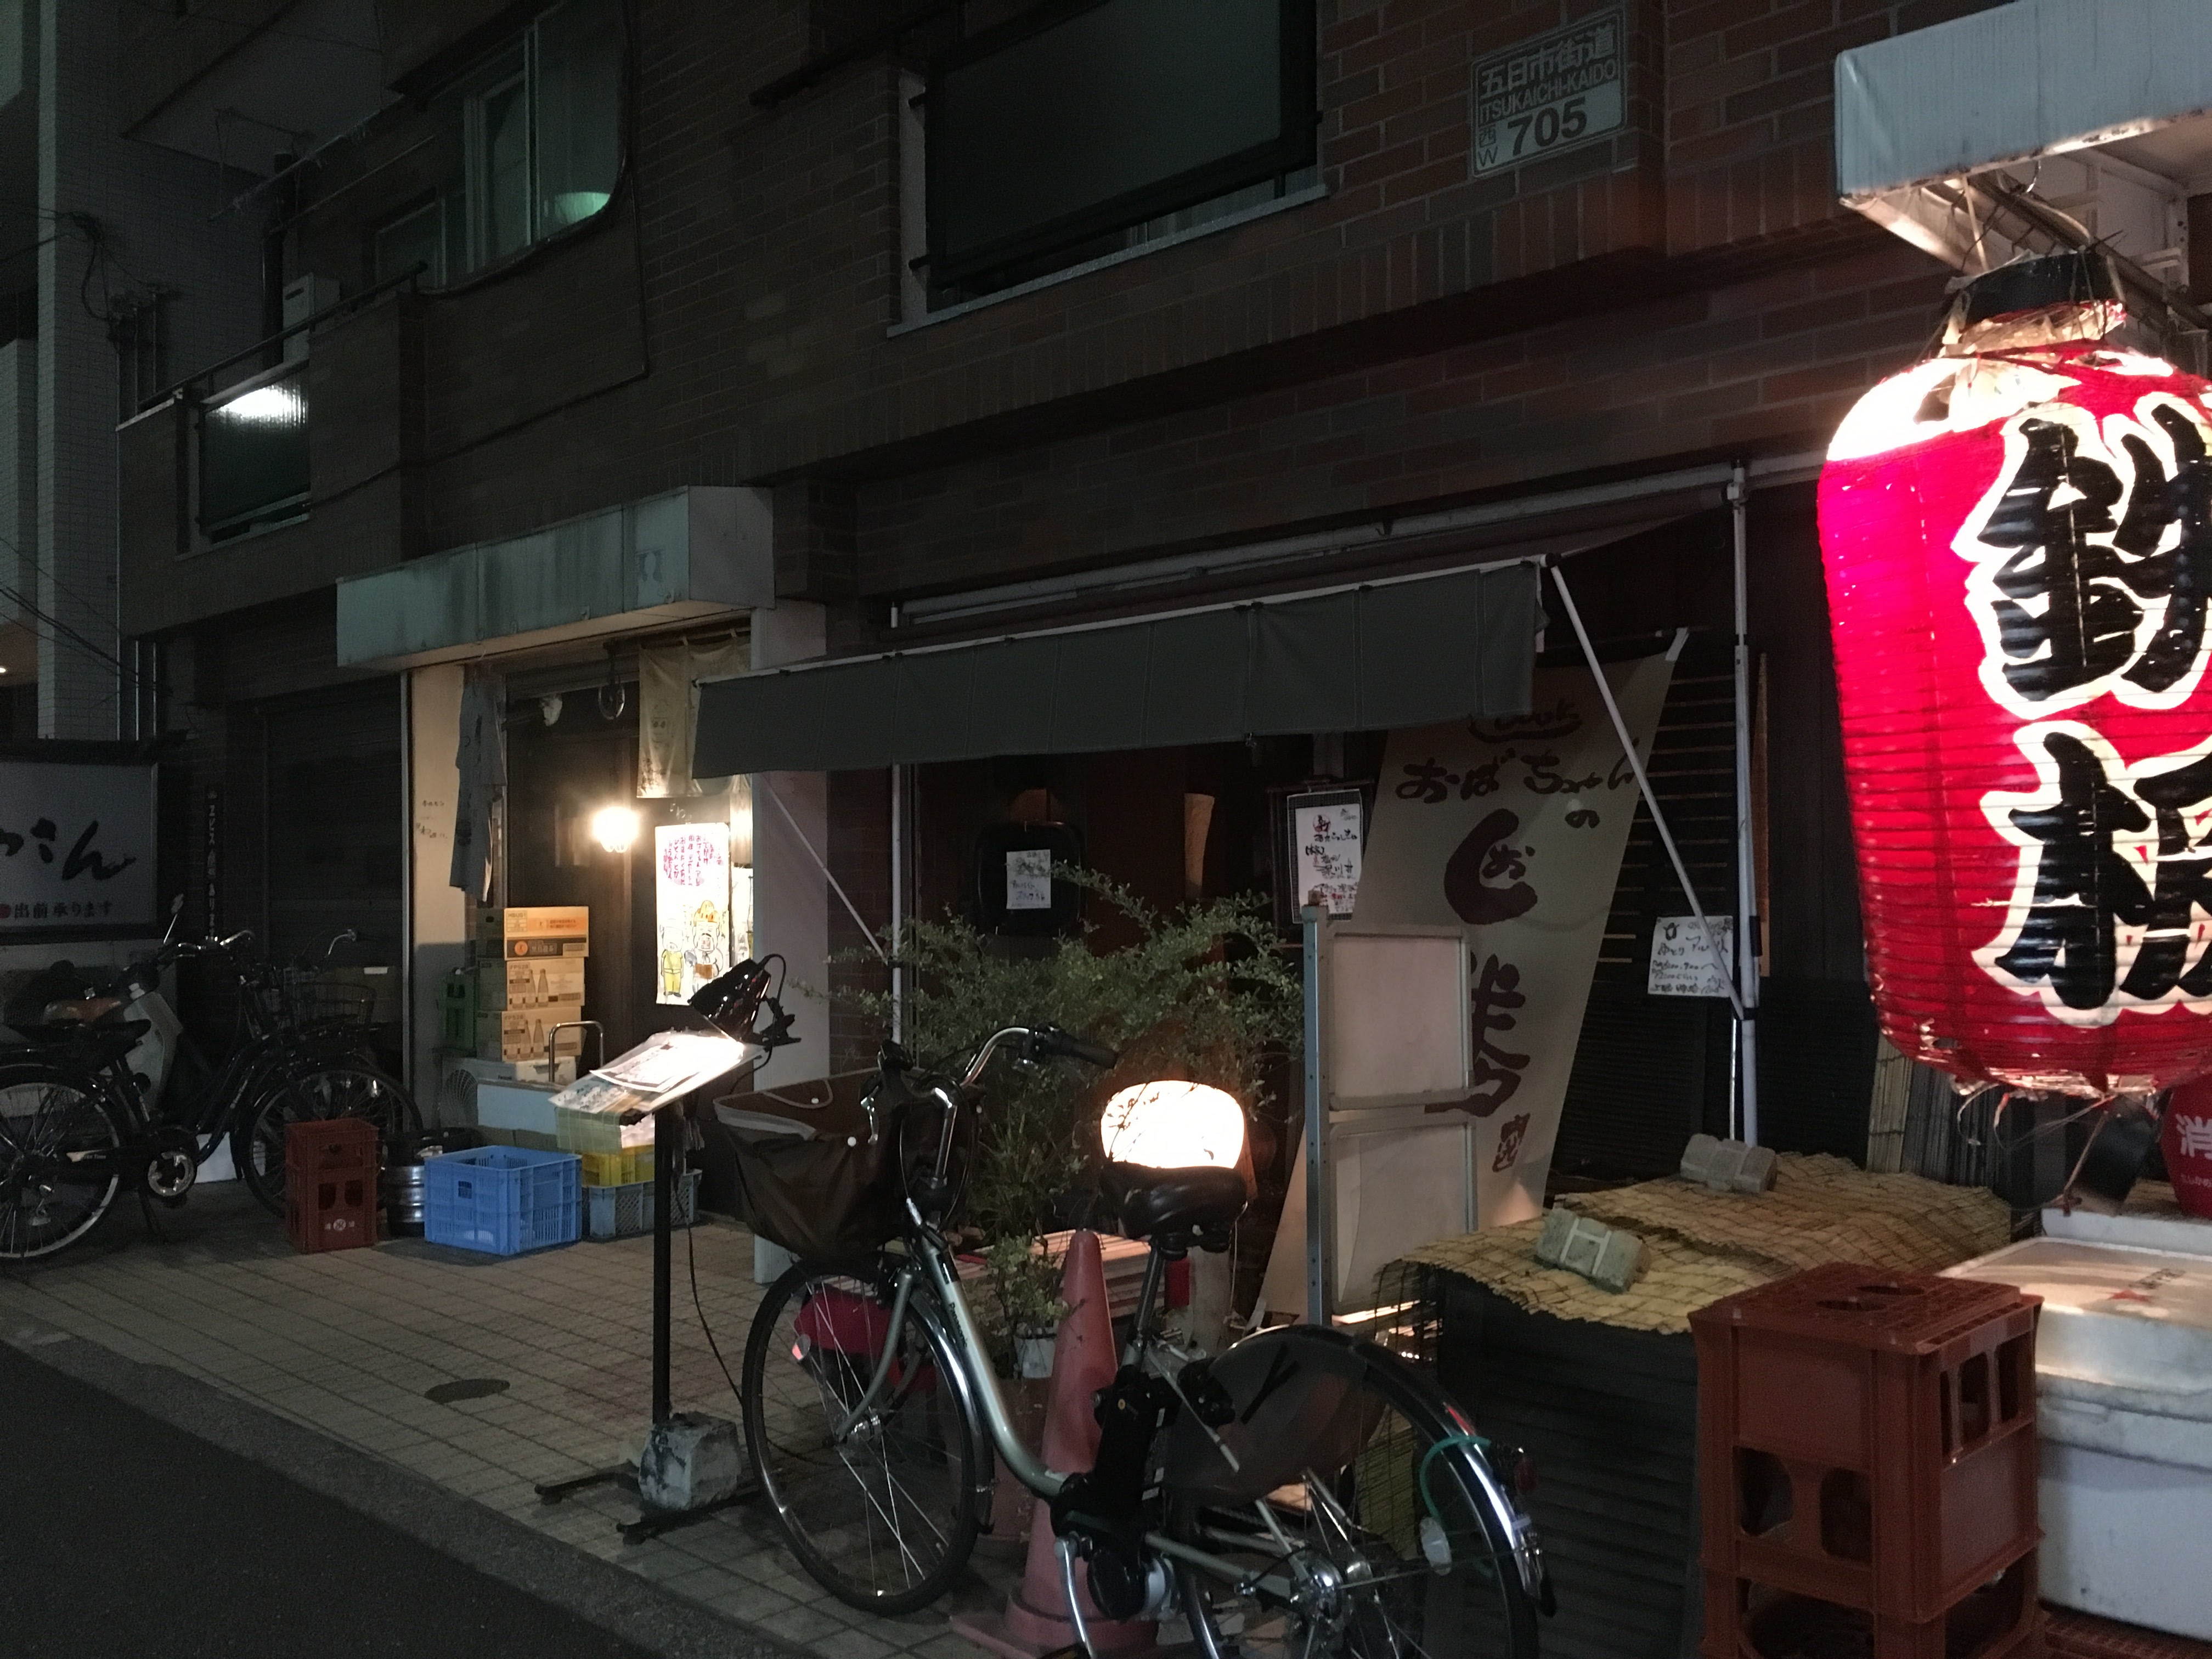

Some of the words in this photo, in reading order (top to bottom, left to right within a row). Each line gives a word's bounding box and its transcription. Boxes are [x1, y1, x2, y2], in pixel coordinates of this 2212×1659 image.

[1481, 23, 1616, 98] 五日市街道
[1508, 96, 1587, 156] 705
[1478, 146, 1498, 167] W
